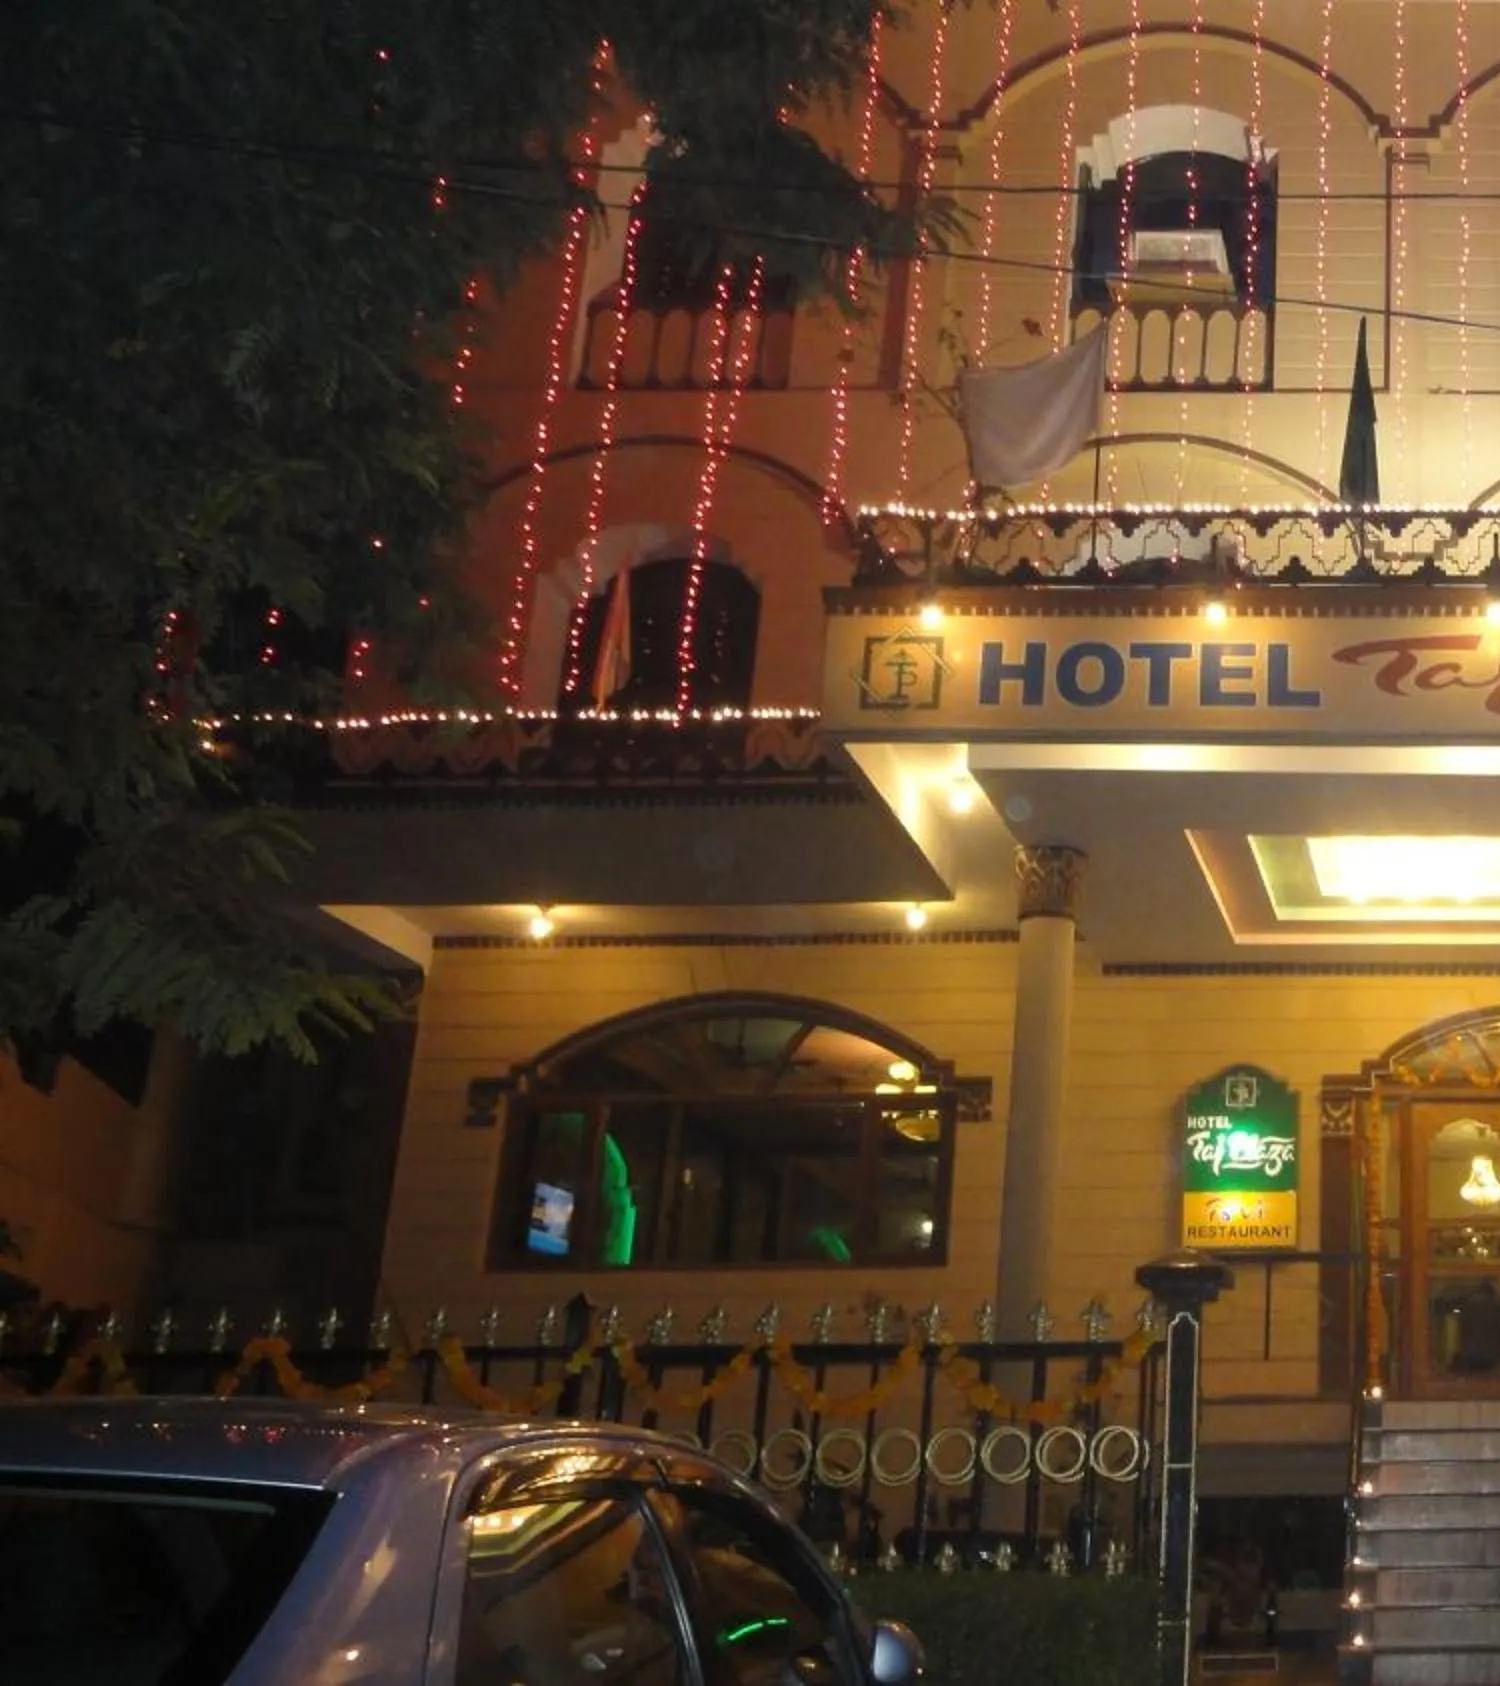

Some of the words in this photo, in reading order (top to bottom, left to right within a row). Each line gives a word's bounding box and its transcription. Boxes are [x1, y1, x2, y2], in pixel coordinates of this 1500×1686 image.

[979, 641, 1321, 706] HOTEL
[1187, 1115, 1233, 1129] HOTEL
[1186, 1130, 1226, 1176] Taj
[1224, 1130, 1296, 1177] aza
[1186, 1225, 1292, 1239] RESTAURANT
